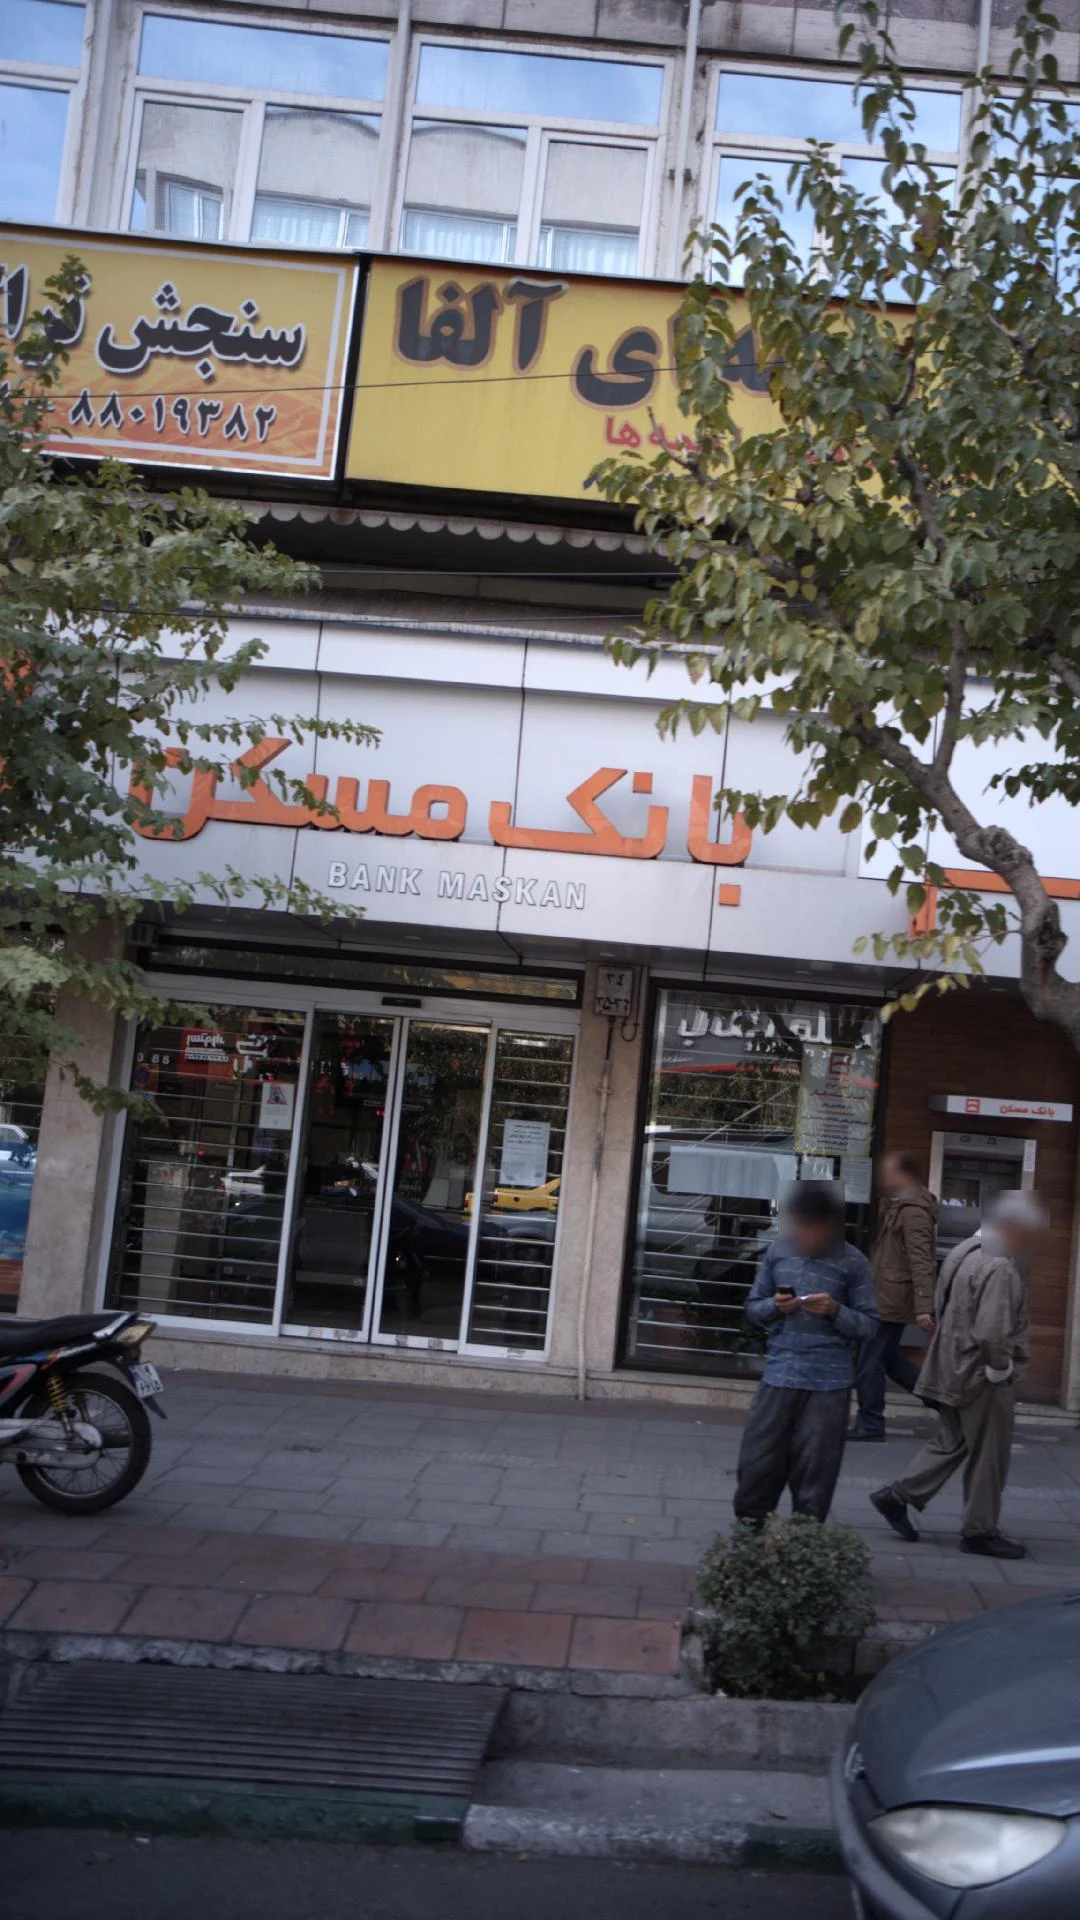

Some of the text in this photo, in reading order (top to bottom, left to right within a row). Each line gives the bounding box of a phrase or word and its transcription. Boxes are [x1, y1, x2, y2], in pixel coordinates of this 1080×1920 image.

[95, 280, 306, 380] سنجش
[395, 274, 568, 372] آلفا
[69, 389, 277, 442] ۸۸۰۱۹۳۸۲
[130, 737, 753, 906] بانک مسکن
[328, 860, 586, 911] BANK MASKAN
[999, 1103, 1055, 1118] بانک مسکن
